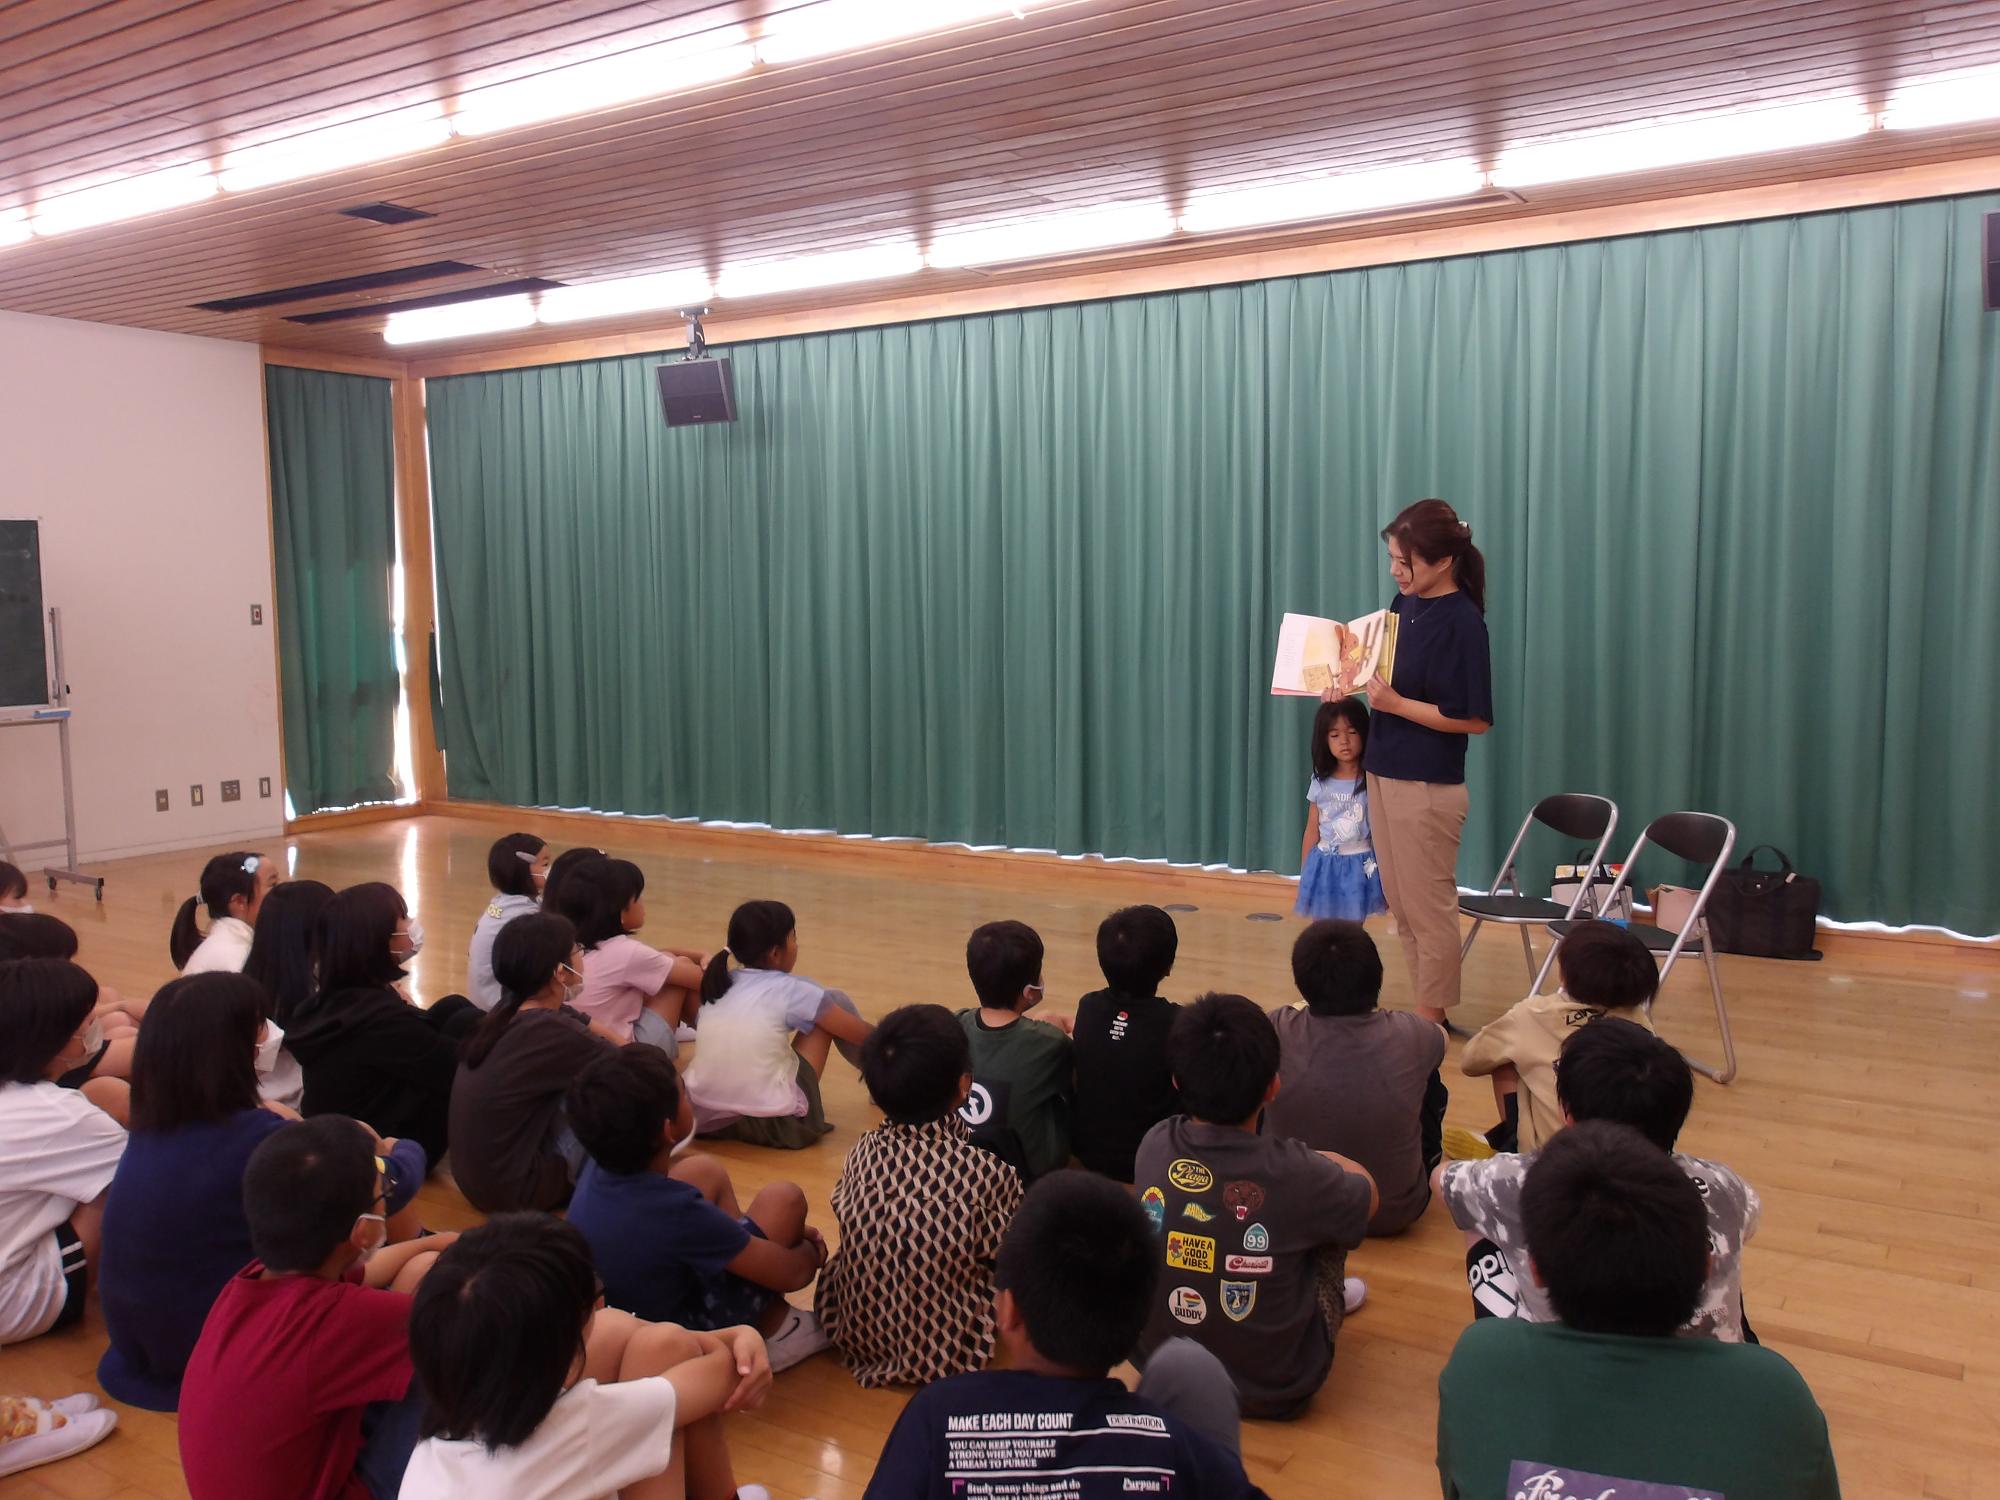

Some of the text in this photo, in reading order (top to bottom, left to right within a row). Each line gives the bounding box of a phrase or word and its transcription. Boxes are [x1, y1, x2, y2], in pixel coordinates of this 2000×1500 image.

[1183, 1237, 1213, 1250] HAVE A
[1247, 1235, 1266, 1248] 99
[1184, 1248, 1208, 1259] GOOD
[1182, 1256, 1211, 1270] VIBES.
[1177, 1290, 1181, 1306] I
[1174, 1307, 1202, 1320] BUDDY
[948, 1413, 1073, 1431] MAKE EACH DAY COUNT
[1110, 1417, 1162, 1429] DESTINATION
[949, 1439, 1056, 1450] YOU CAN KEEP YOURSELF
[949, 1448, 1056, 1459] STRONG WHEN YOU HAVE
[949, 1458, 1037, 1469] A DREAM TO PURSUE
[967, 1479, 1081, 1496] Study many things and do
